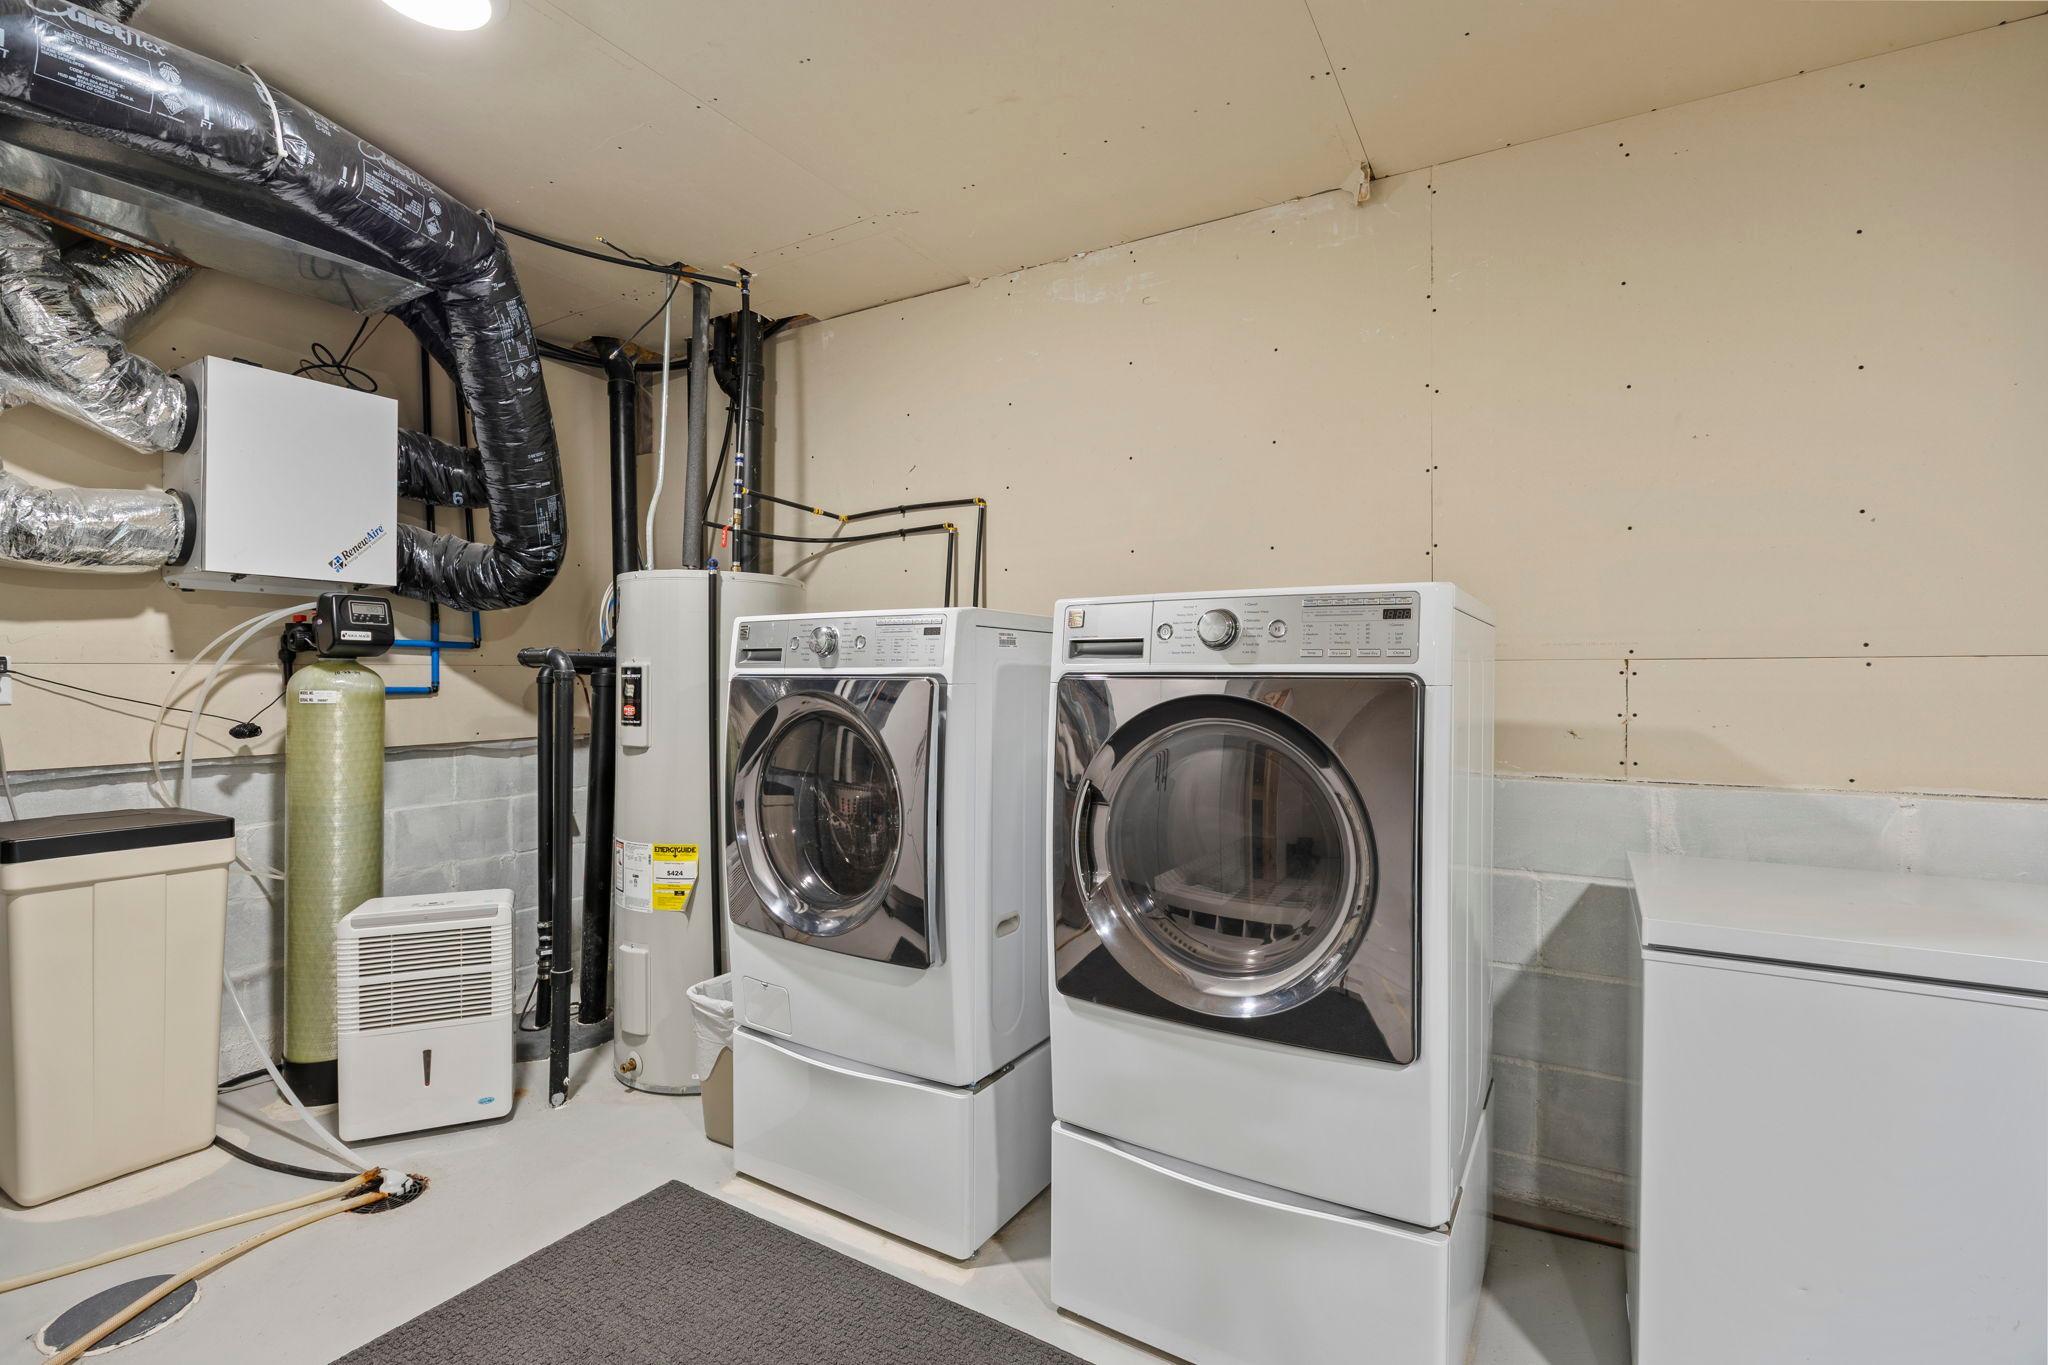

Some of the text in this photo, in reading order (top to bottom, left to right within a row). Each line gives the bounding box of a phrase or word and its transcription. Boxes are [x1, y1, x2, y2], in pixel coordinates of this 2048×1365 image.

[96, 47, 128, 62] STANDARD
[200, 120, 214, 130] FT
[338, 179, 349, 189] FT
[445, 240, 455, 249] FT
[452, 491, 464, 505] 6
[341, 525, 384, 561] RenewAire
[654, 846, 697, 855] ENERGYGUIDE
